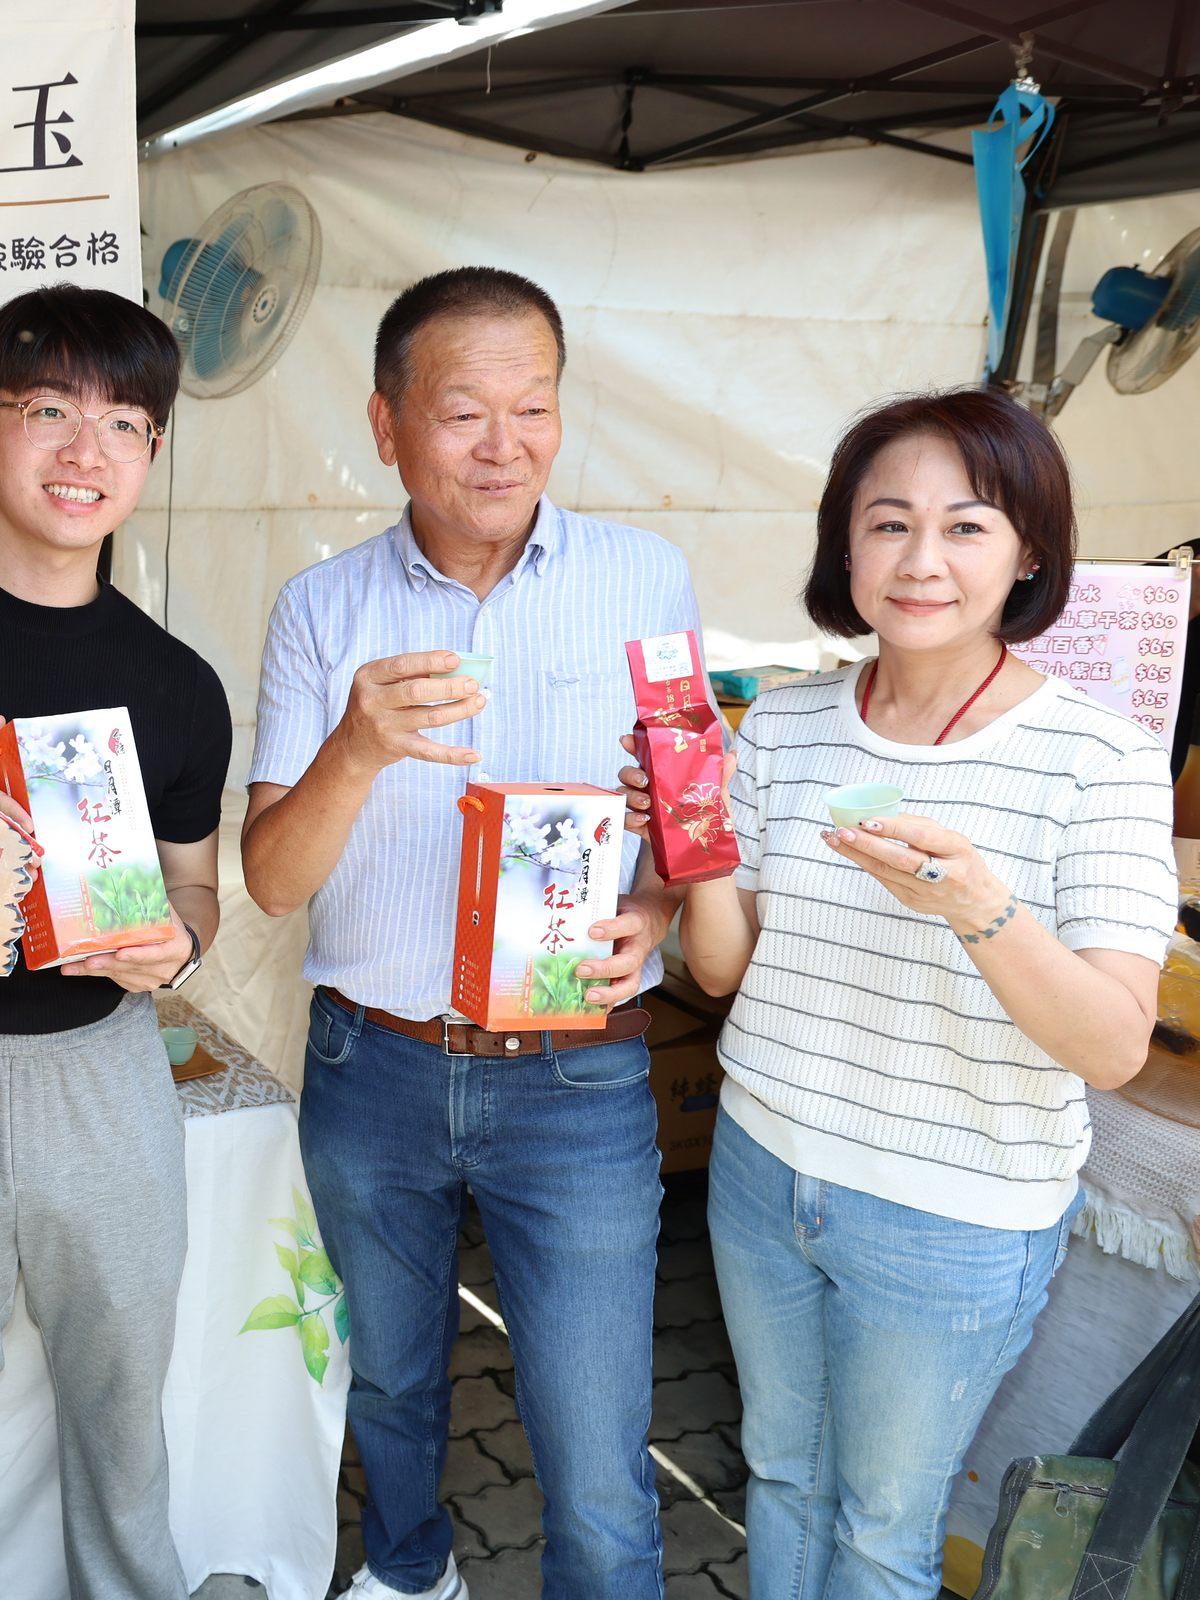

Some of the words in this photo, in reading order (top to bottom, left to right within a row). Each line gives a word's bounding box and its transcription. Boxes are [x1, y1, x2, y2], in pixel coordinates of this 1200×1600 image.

[1143, 586, 1179, 604] $60
[1141, 612, 1178, 630] $60
[1138, 637, 1174, 657] $65
[1135, 663, 1171, 683] $65
[1132, 689, 1168, 708] $65
[77, 798, 122, 870] 紅茶
[539, 883, 576, 955] 紅茶
